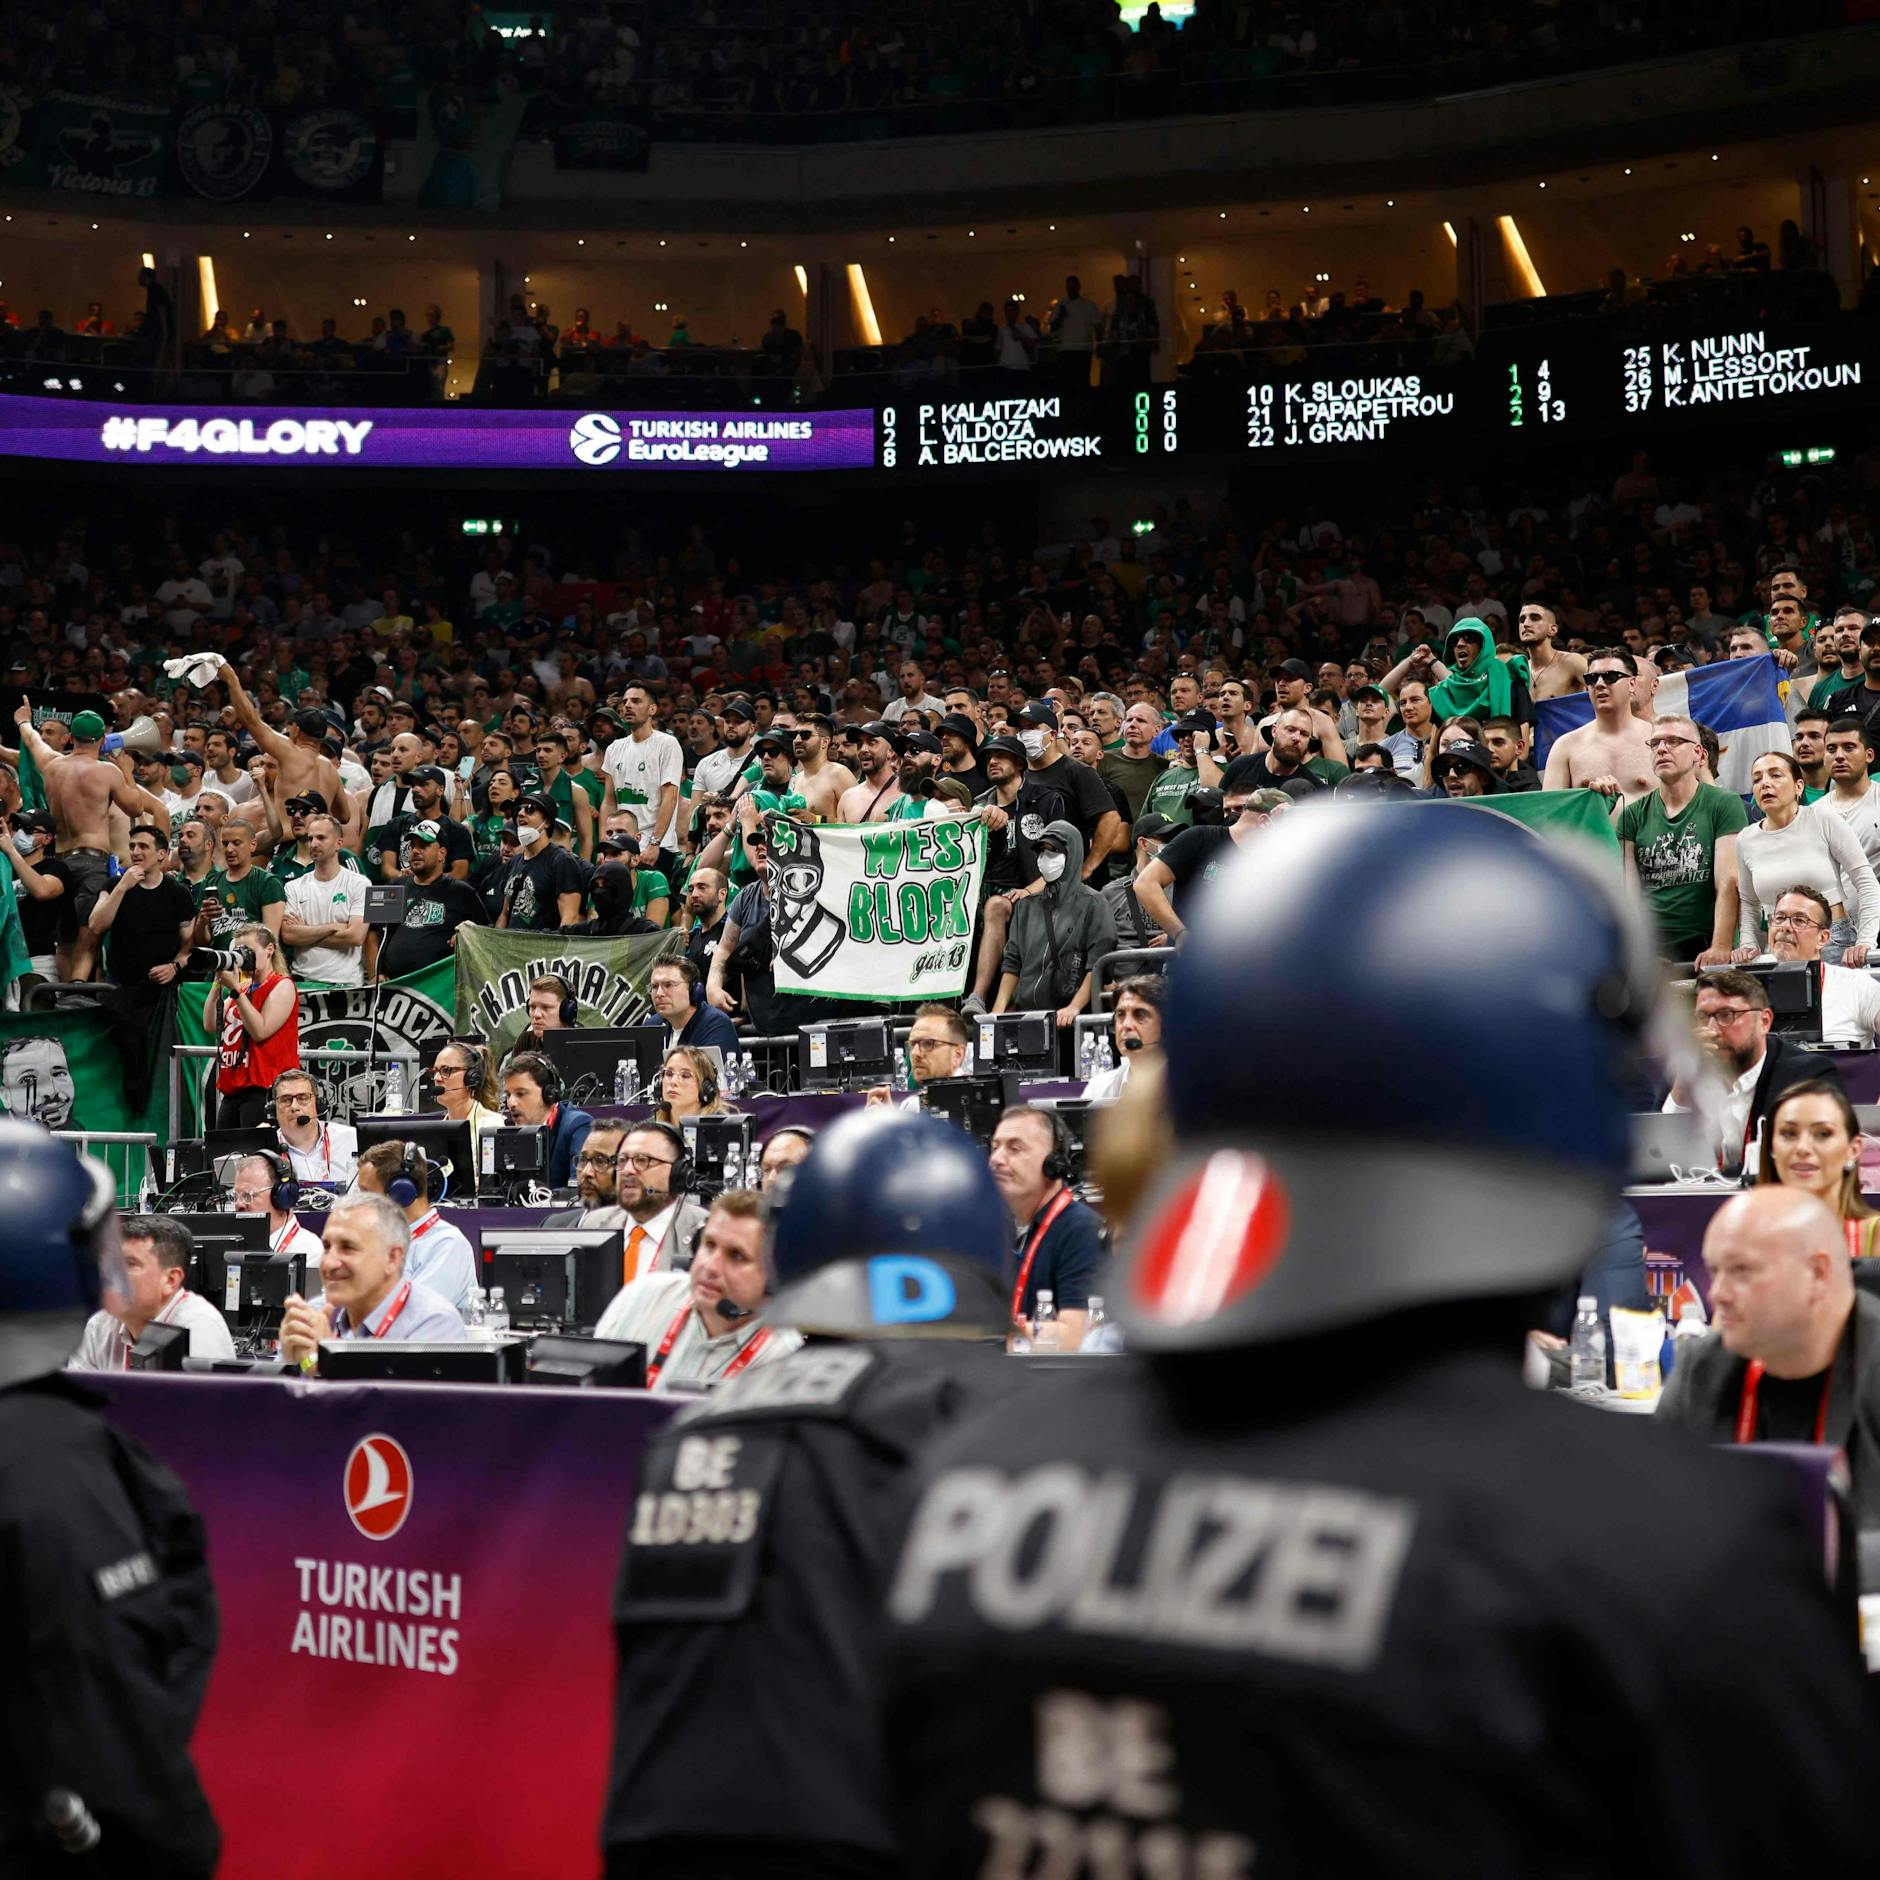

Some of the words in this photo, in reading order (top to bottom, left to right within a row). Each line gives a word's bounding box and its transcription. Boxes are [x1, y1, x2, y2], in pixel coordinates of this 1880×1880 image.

[1623, 346, 1651, 370] 25
[1662, 342, 1685, 365] K.
[1691, 331, 1765, 362] NUNN
[1508, 363, 1518, 384] 1
[1537, 359, 1550, 380] 4
[1624, 367, 1652, 391] 26
[1663, 365, 1688, 387] M.
[1694, 346, 1810, 383] LESSORT
[1135, 392, 1149, 413] 0
[1163, 390, 1176, 411] 5
[1247, 385, 1273, 406] 10
[1284, 383, 1306, 404] K.
[1312, 376, 1420, 402] SLOUKAS
[1509, 384, 1522, 405] 2
[1537, 381, 1551, 402] 9
[1625, 389, 1652, 413] 37
[882, 407, 896, 426] 0
[919, 405, 936, 425] P.
[942, 397, 1060, 423] KALAITZAKI
[1135, 413, 1149, 433] 0
[1163, 412, 1177, 431] 0
[1247, 406, 1271, 427] 21
[1285, 405, 1297, 425] I.
[1302, 393, 1454, 424] PAPAPETROU
[1510, 405, 1523, 426] 2
[1538, 400, 1566, 422] 13
[101, 416, 373, 455] #F4GLORY
[628, 420, 718, 438] TURKISH
[722, 420, 812, 439] AIRLINES
[883, 428, 896, 447] 2
[920, 425, 938, 446] L.
[941, 420, 1036, 444] VILDOZA
[1135, 432, 1149, 453] 0
[1163, 432, 1177, 452] 0
[1248, 426, 1274, 447] 22
[1284, 424, 1303, 445] J.
[1308, 418, 1390, 444] GRANT
[628, 439, 768, 468] EuroLeague
[883, 448, 896, 467] 8
[918, 445, 938, 465] A.
[943, 436, 1101, 464] BALCEROWSK
[861, 816, 982, 878] WEST
[848, 871, 971, 945] BLOCK
[911, 947, 944, 983] gate
[947, 943, 967, 970] 13
[345, 990, 453, 1046] BLOCK
[868, 1254, 957, 1326] D
[673, 1435, 743, 1491] BE
[889, 1460, 1416, 1675] POLIZEI
[294, 1557, 462, 1621] TURKISH
[290, 1610, 460, 1676] AIRLINES
